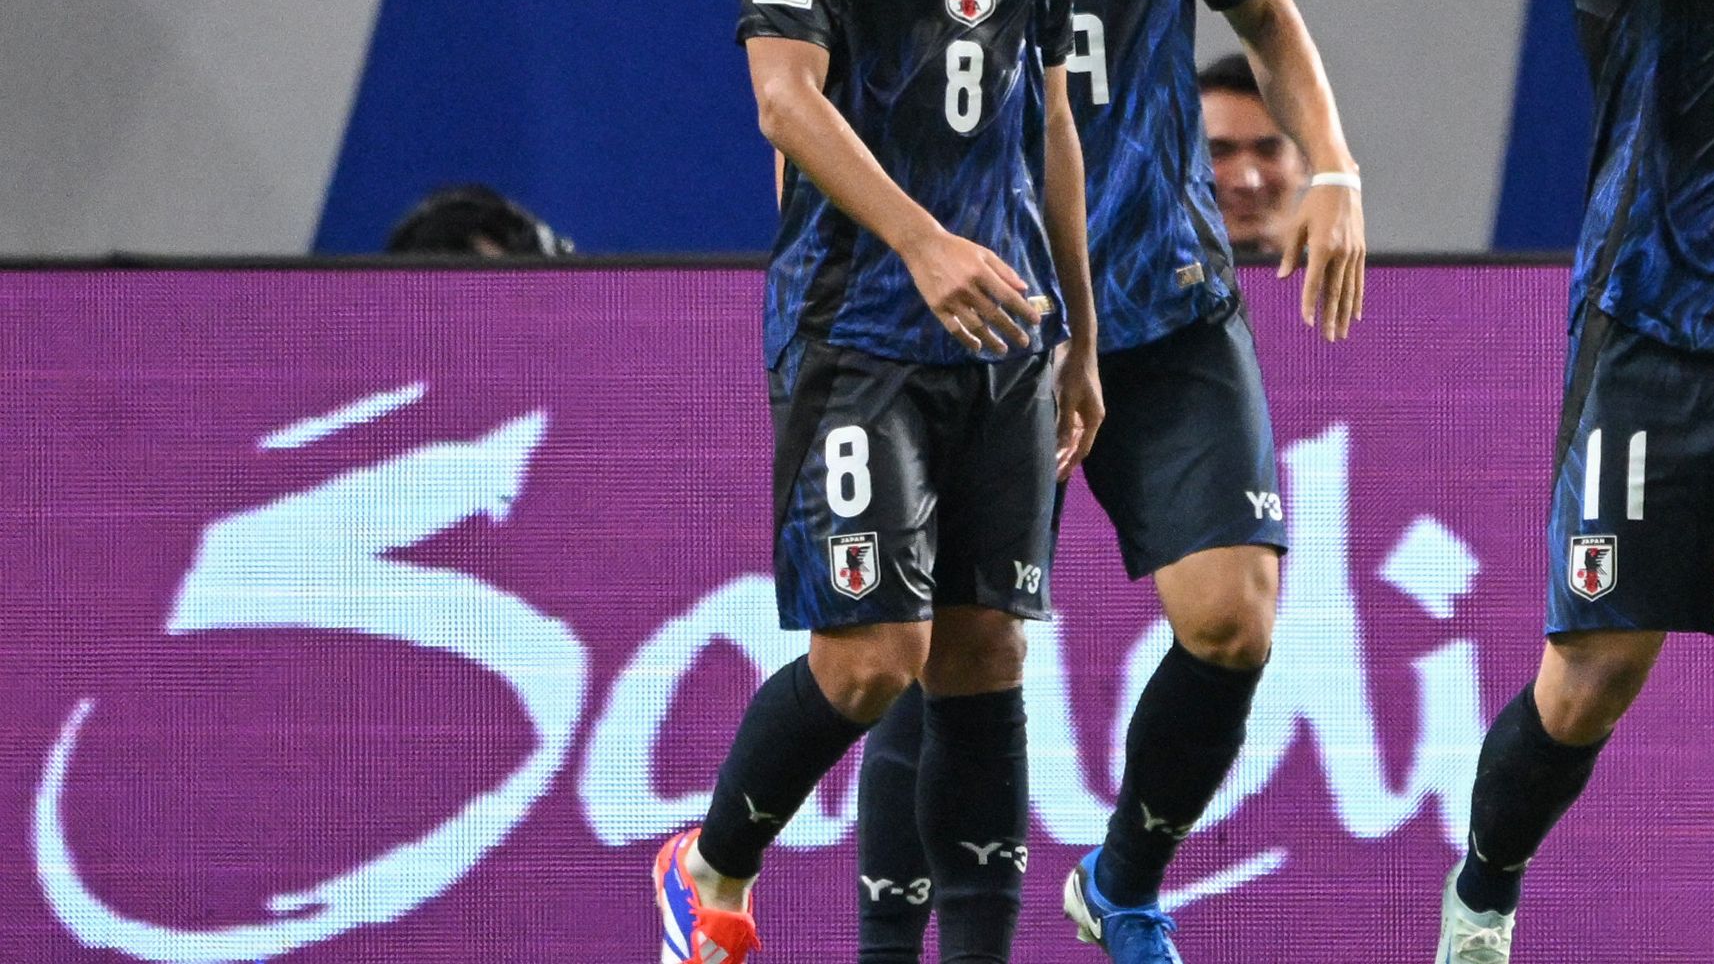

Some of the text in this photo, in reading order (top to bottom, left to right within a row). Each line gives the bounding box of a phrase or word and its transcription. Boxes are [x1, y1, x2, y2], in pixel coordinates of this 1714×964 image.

[945, 39, 984, 134] 8
[825, 425, 872, 518] 8
[1583, 428, 1647, 520] 11
[1246, 490, 1284, 521] Y-3
[840, 536, 865, 544] JAPAN
[1014, 560, 1042, 594] Y-3
[961, 841, 1028, 874] Y-3
[861, 875, 932, 905] Y-3
